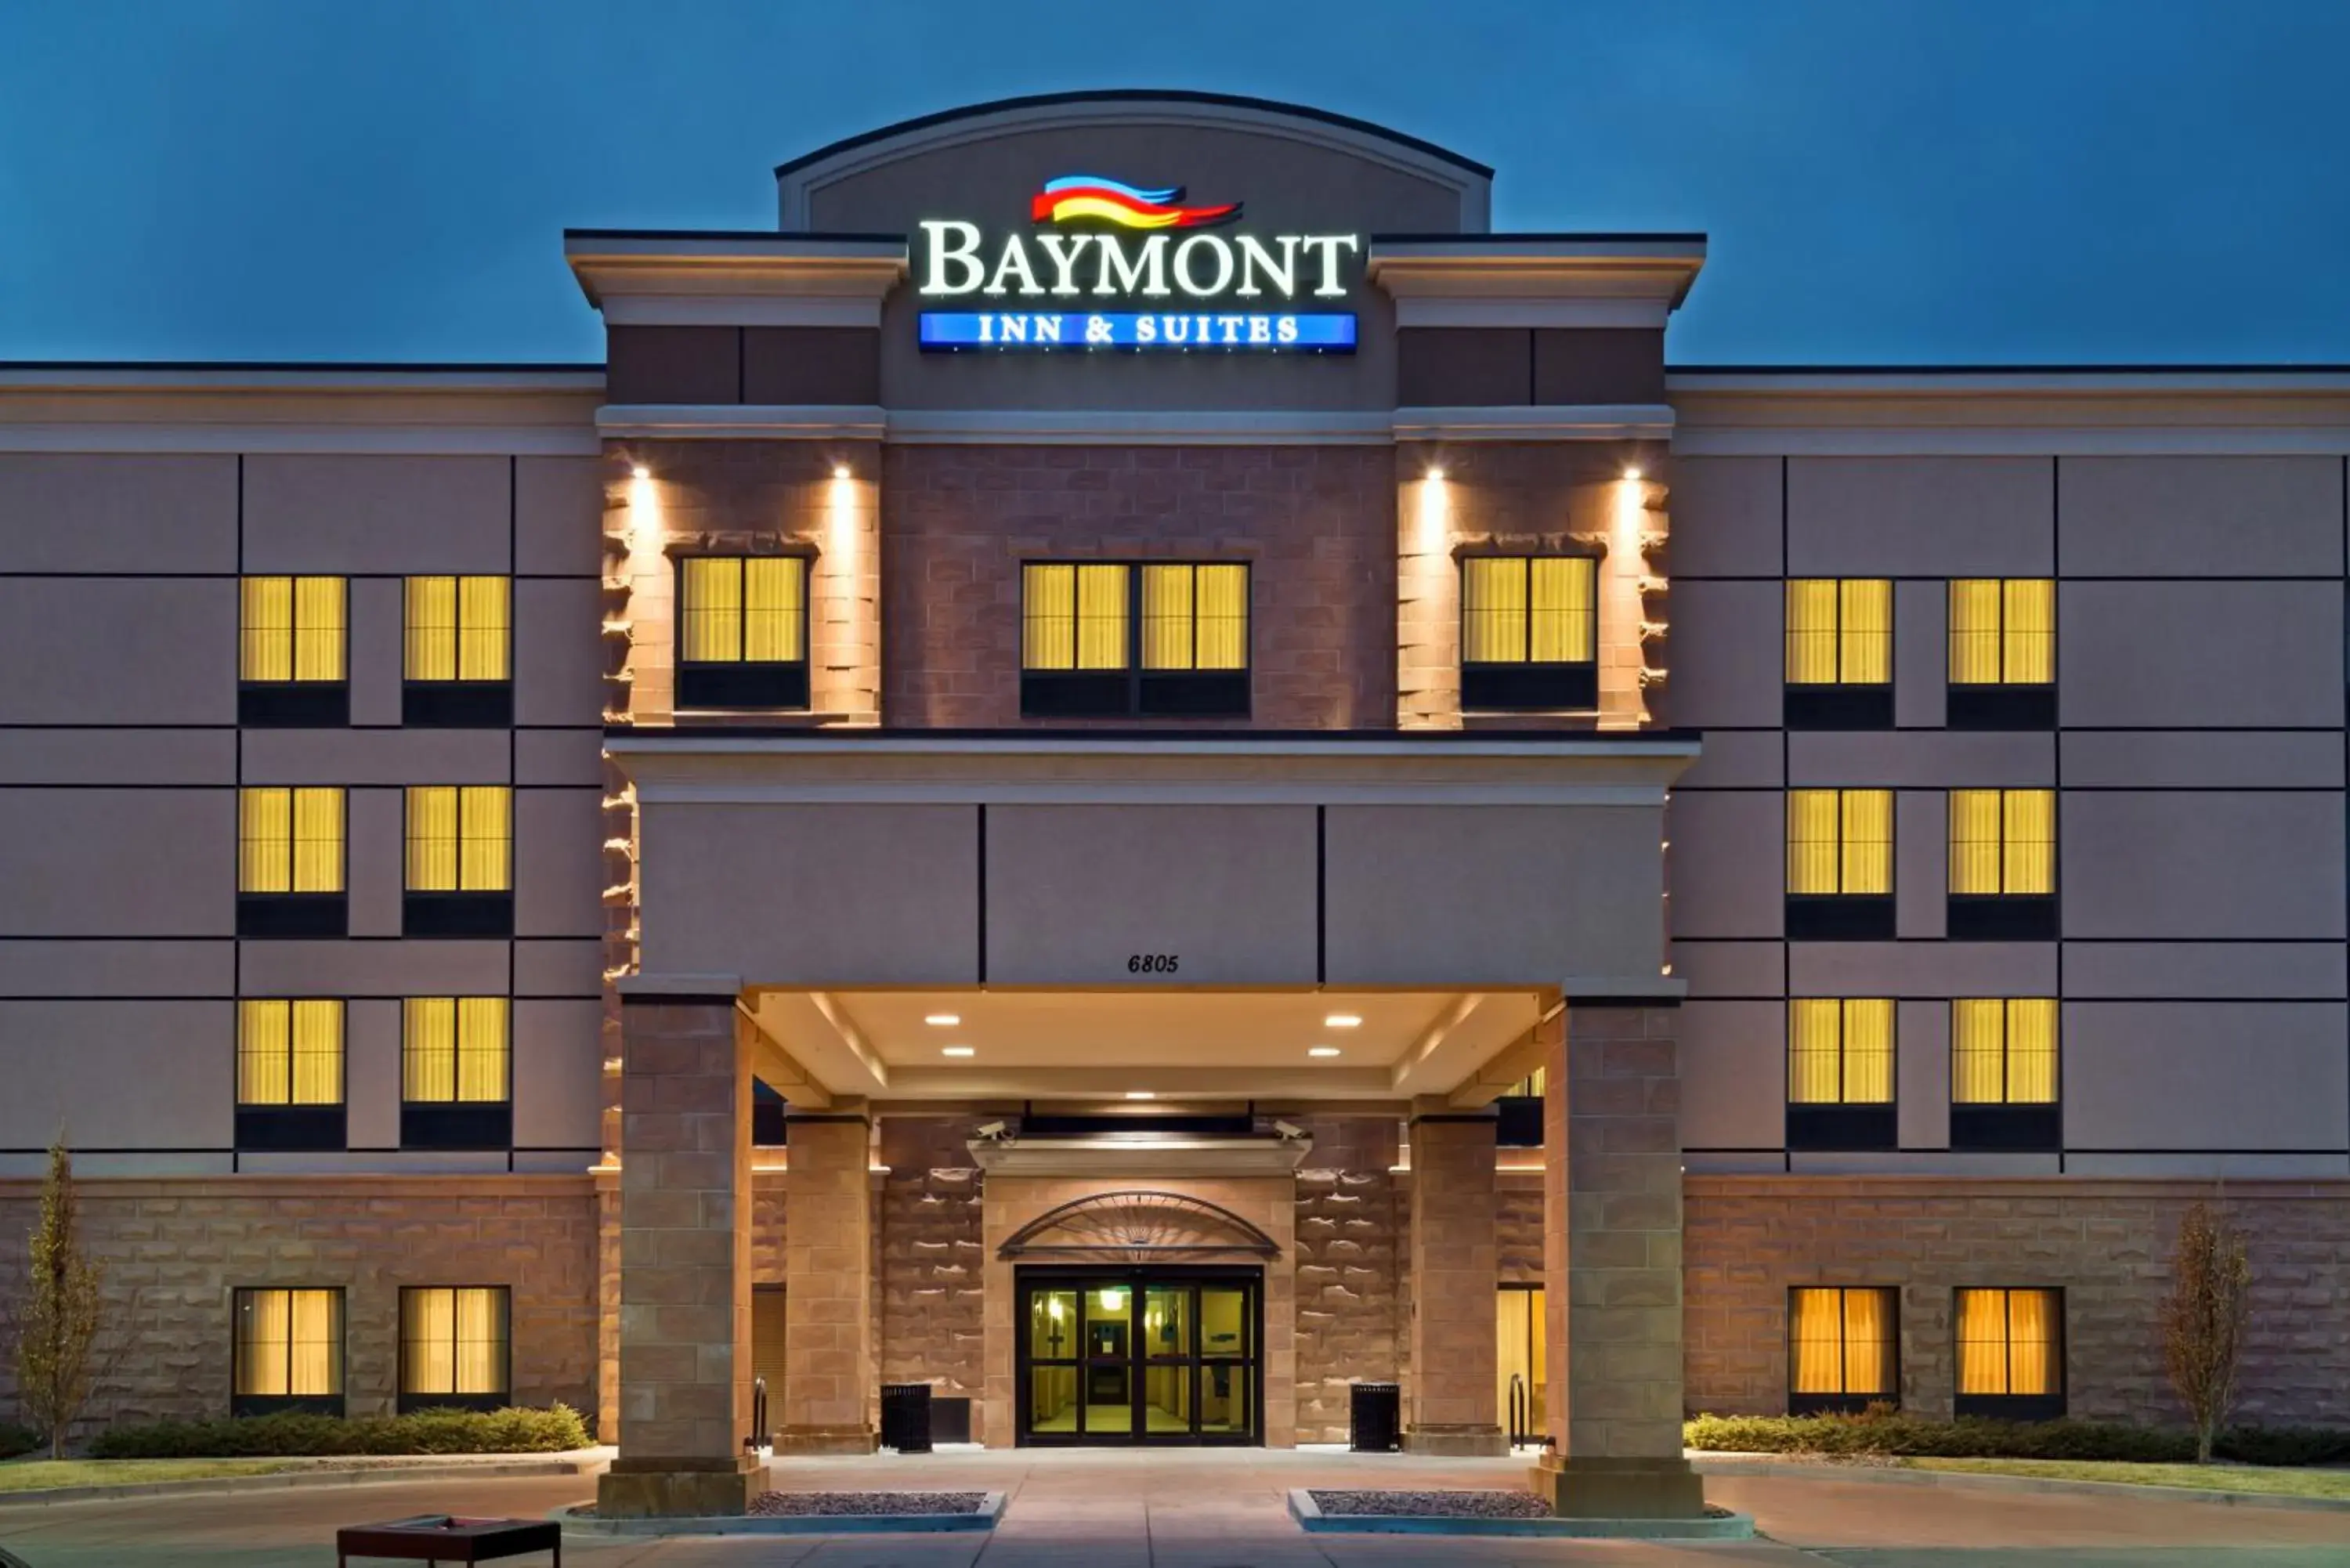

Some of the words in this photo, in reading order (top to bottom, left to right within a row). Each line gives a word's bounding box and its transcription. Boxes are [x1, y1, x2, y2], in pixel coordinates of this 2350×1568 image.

[919, 220, 1358, 297] BAYMONT
[978, 315, 1062, 342] INN
[1085, 315, 1114, 343] &
[1137, 315, 1300, 343] SUITES
[1128, 954, 1179, 974] 6805
